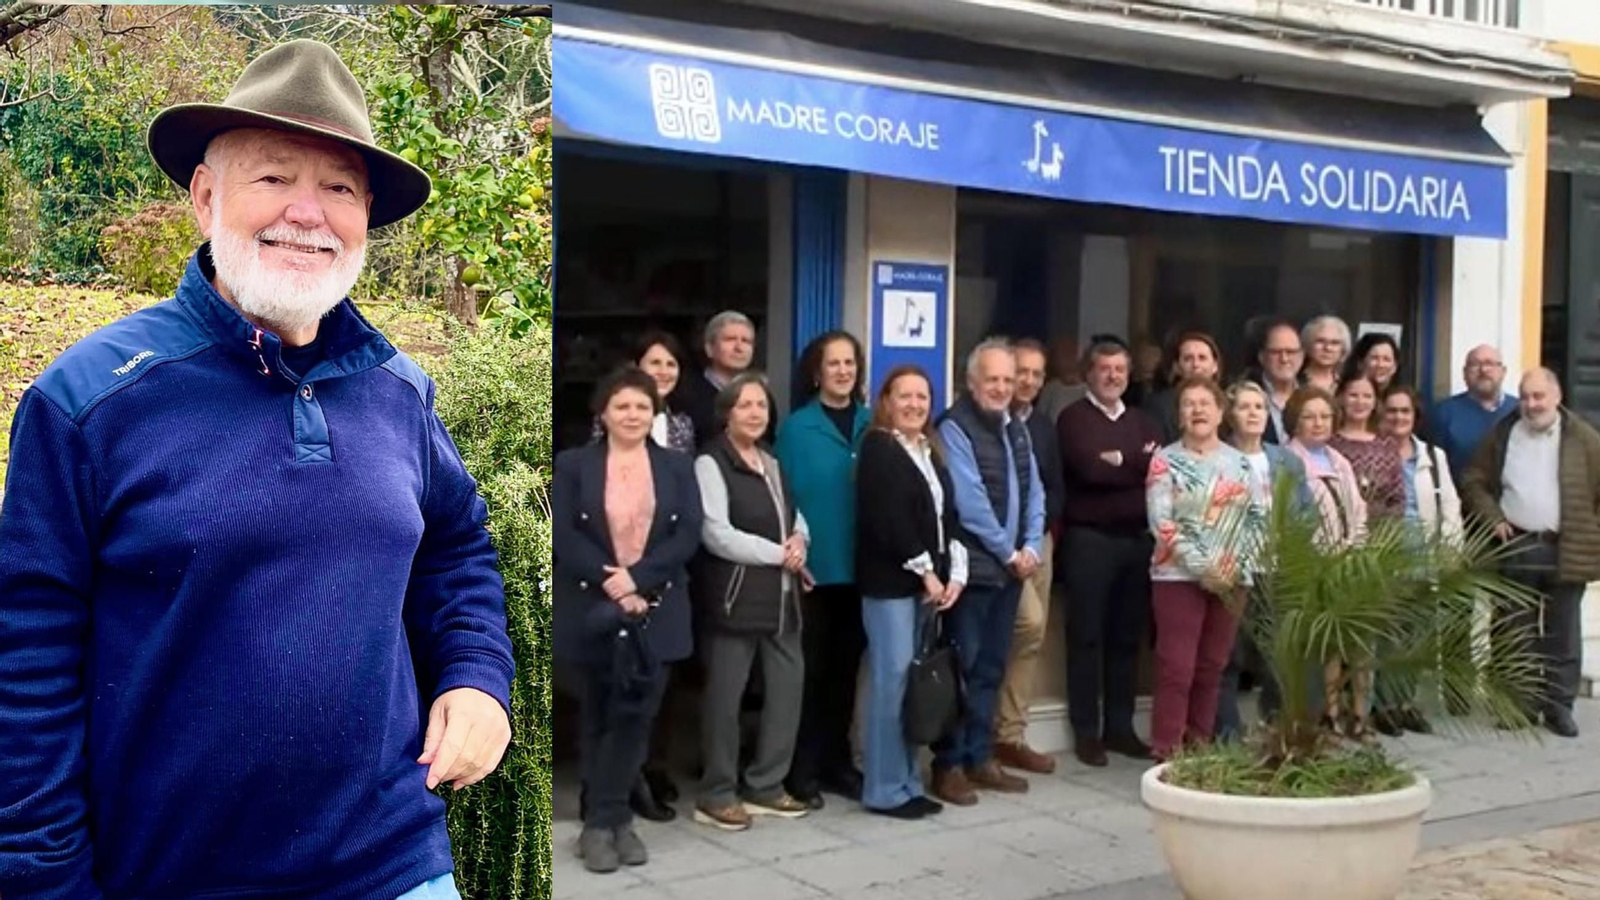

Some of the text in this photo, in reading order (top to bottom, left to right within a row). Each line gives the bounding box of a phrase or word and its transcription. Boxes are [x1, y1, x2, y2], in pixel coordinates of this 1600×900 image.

[727, 98, 939, 149] MADRE CORAJE
[1158, 146, 1471, 221] TIENDA SOLIDARIA
